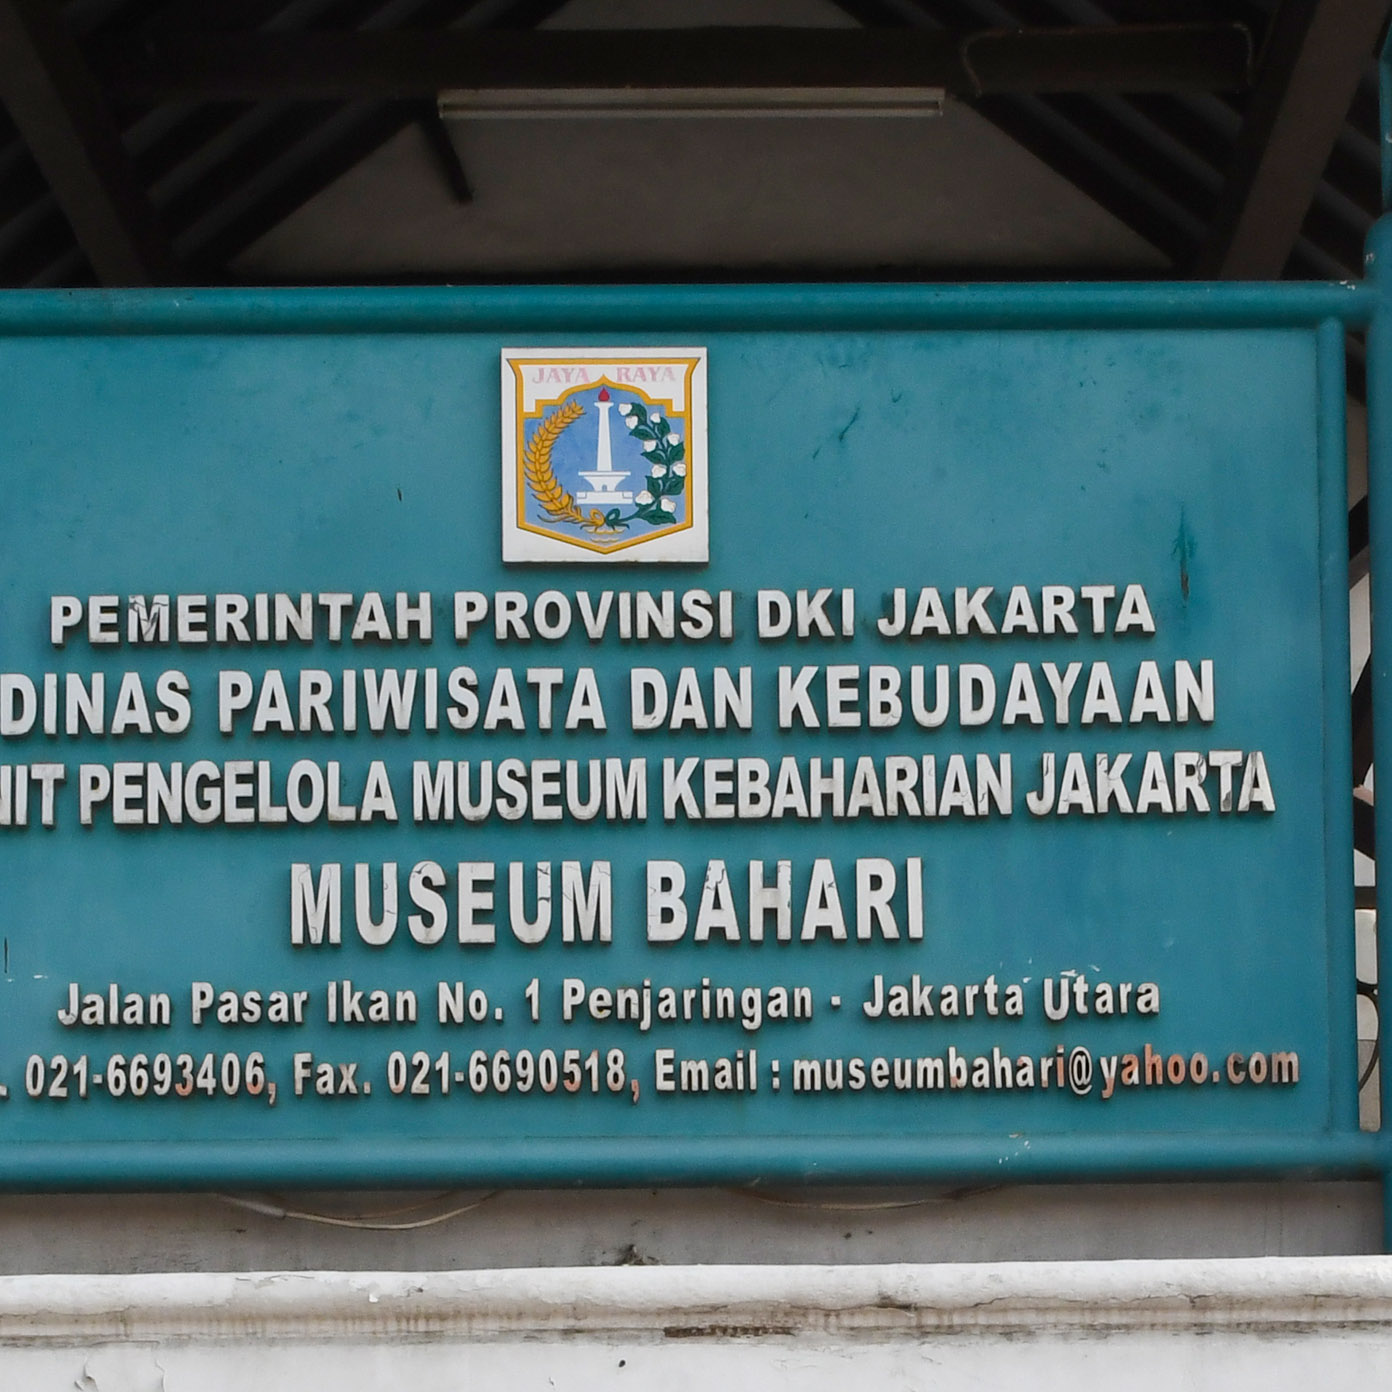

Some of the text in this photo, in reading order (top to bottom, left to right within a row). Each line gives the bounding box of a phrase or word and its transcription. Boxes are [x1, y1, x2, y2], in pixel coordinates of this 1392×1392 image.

[532, 366, 677, 384] JAYA RAYA
[50, 583, 1156, 645] PEMERINTAH PROVINSI DKI JAKARTA
[218, 666, 607, 734] PARIWISATA
[630, 666, 753, 732] DAN
[778, 659, 1215, 729] KEBUDAYAAN
[79, 759, 399, 826] PENGELOLA
[412, 757, 648, 823] MUSEUM
[663, 752, 1013, 820] KEBAHARIAN
[1025, 750, 1276, 817] JAKARTA
[290, 856, 924, 947] MUSEUM BAHARI
[57, 982, 171, 1027] Jalan
[191, 981, 308, 1025] Pasar
[327, 980, 418, 1024] Ikan
[437, 981, 504, 1024] No.
[524, 977, 541, 1022] 1
[562, 976, 813, 1032] Penjaringan
[862, 973, 1024, 1018] Jakarta
[1043, 973, 1161, 1022] Utara
[24, 1051, 277, 1106] 021-6693406,
[293, 1051, 371, 1097] Fax.
[386, 1048, 641, 1105] 021-6690518,
[654, 1048, 758, 1093] Email
[792, 1043, 1300, 1100] museumbahari@yahoo.com
